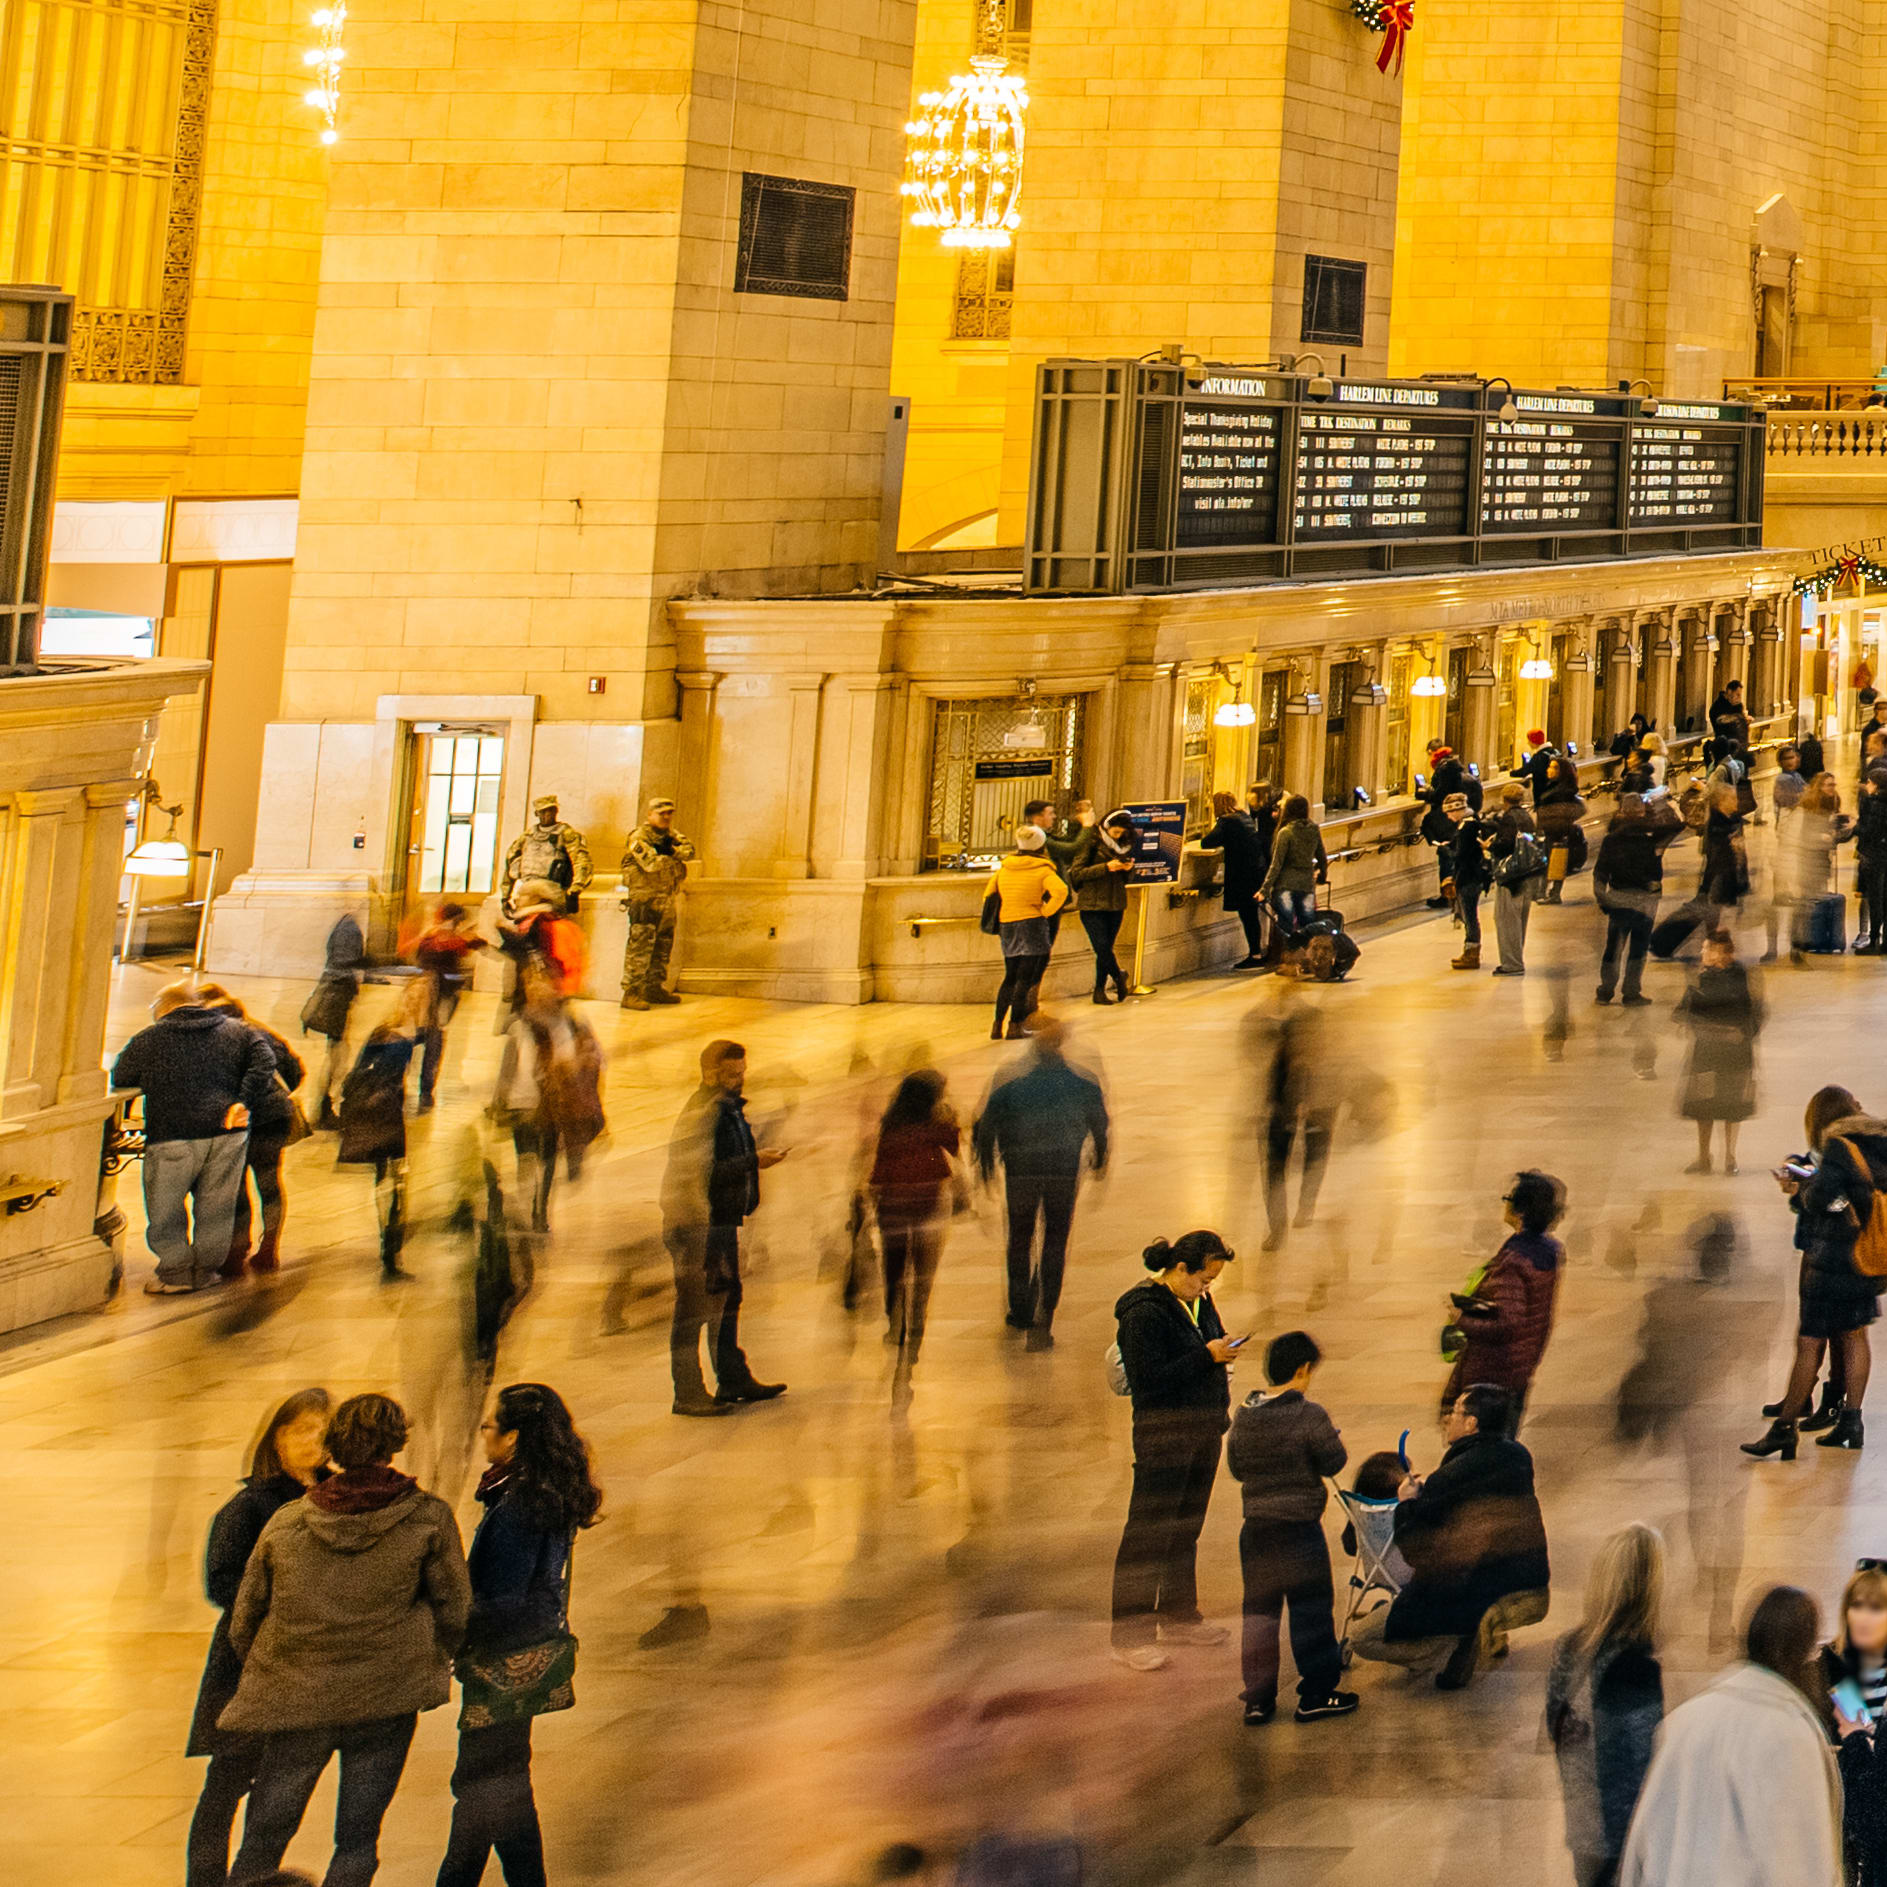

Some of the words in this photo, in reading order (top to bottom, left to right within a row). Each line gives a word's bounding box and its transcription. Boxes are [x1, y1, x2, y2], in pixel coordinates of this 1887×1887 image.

[1200, 377, 1266, 397] INFORMATION
[1339, 385, 1375, 402] HARLEM
[1375, 387, 1393, 404] LINE
[1393, 389, 1439, 406] DEPARTURES
[1809, 537, 1885, 566] TICKET
